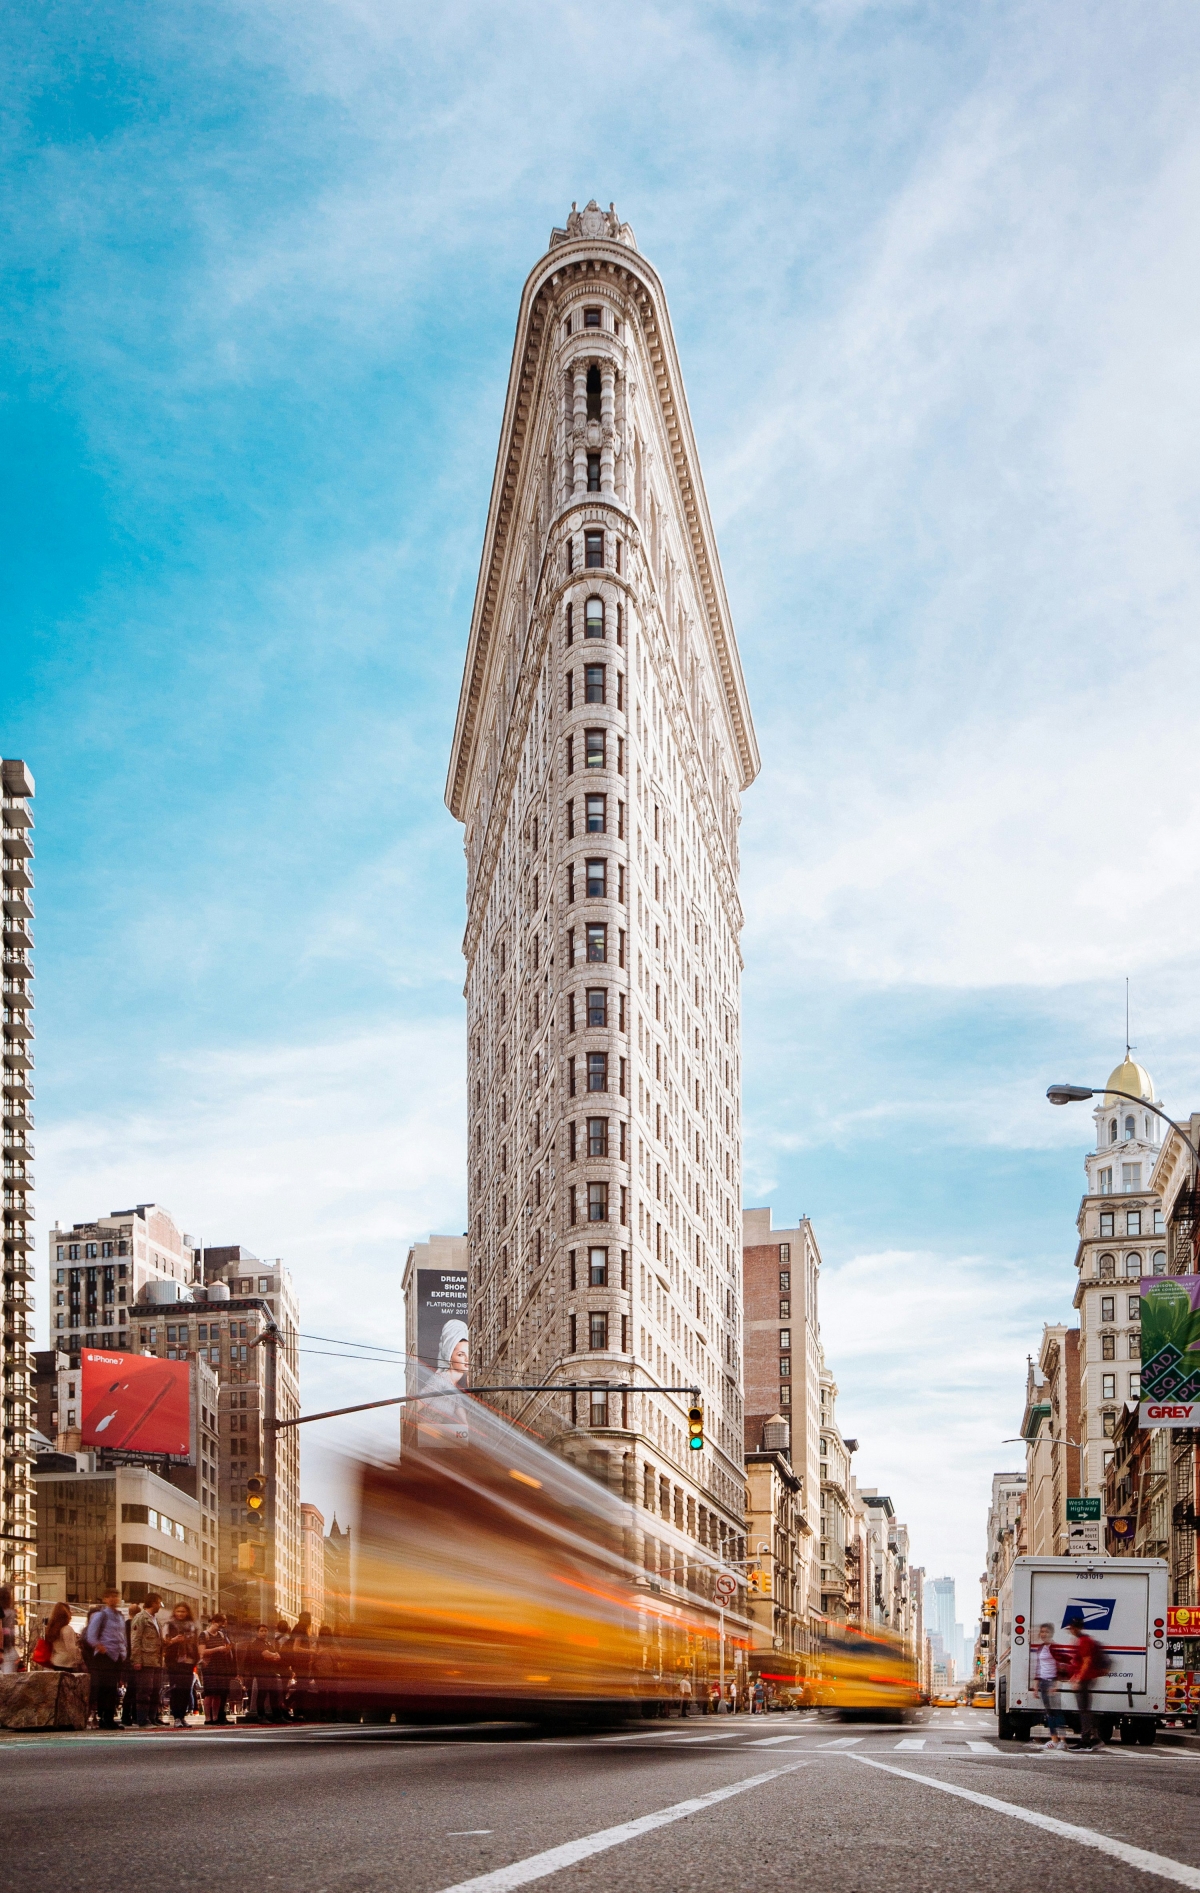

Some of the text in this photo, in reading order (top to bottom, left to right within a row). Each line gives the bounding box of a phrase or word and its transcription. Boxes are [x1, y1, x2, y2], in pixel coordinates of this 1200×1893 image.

[93, 1354, 118, 1364] iPhone
[1141, 1354, 1177, 1384] MAD.
[1153, 1377, 1180, 1397] SQ.
[1147, 1405, 1194, 1418] GREY
